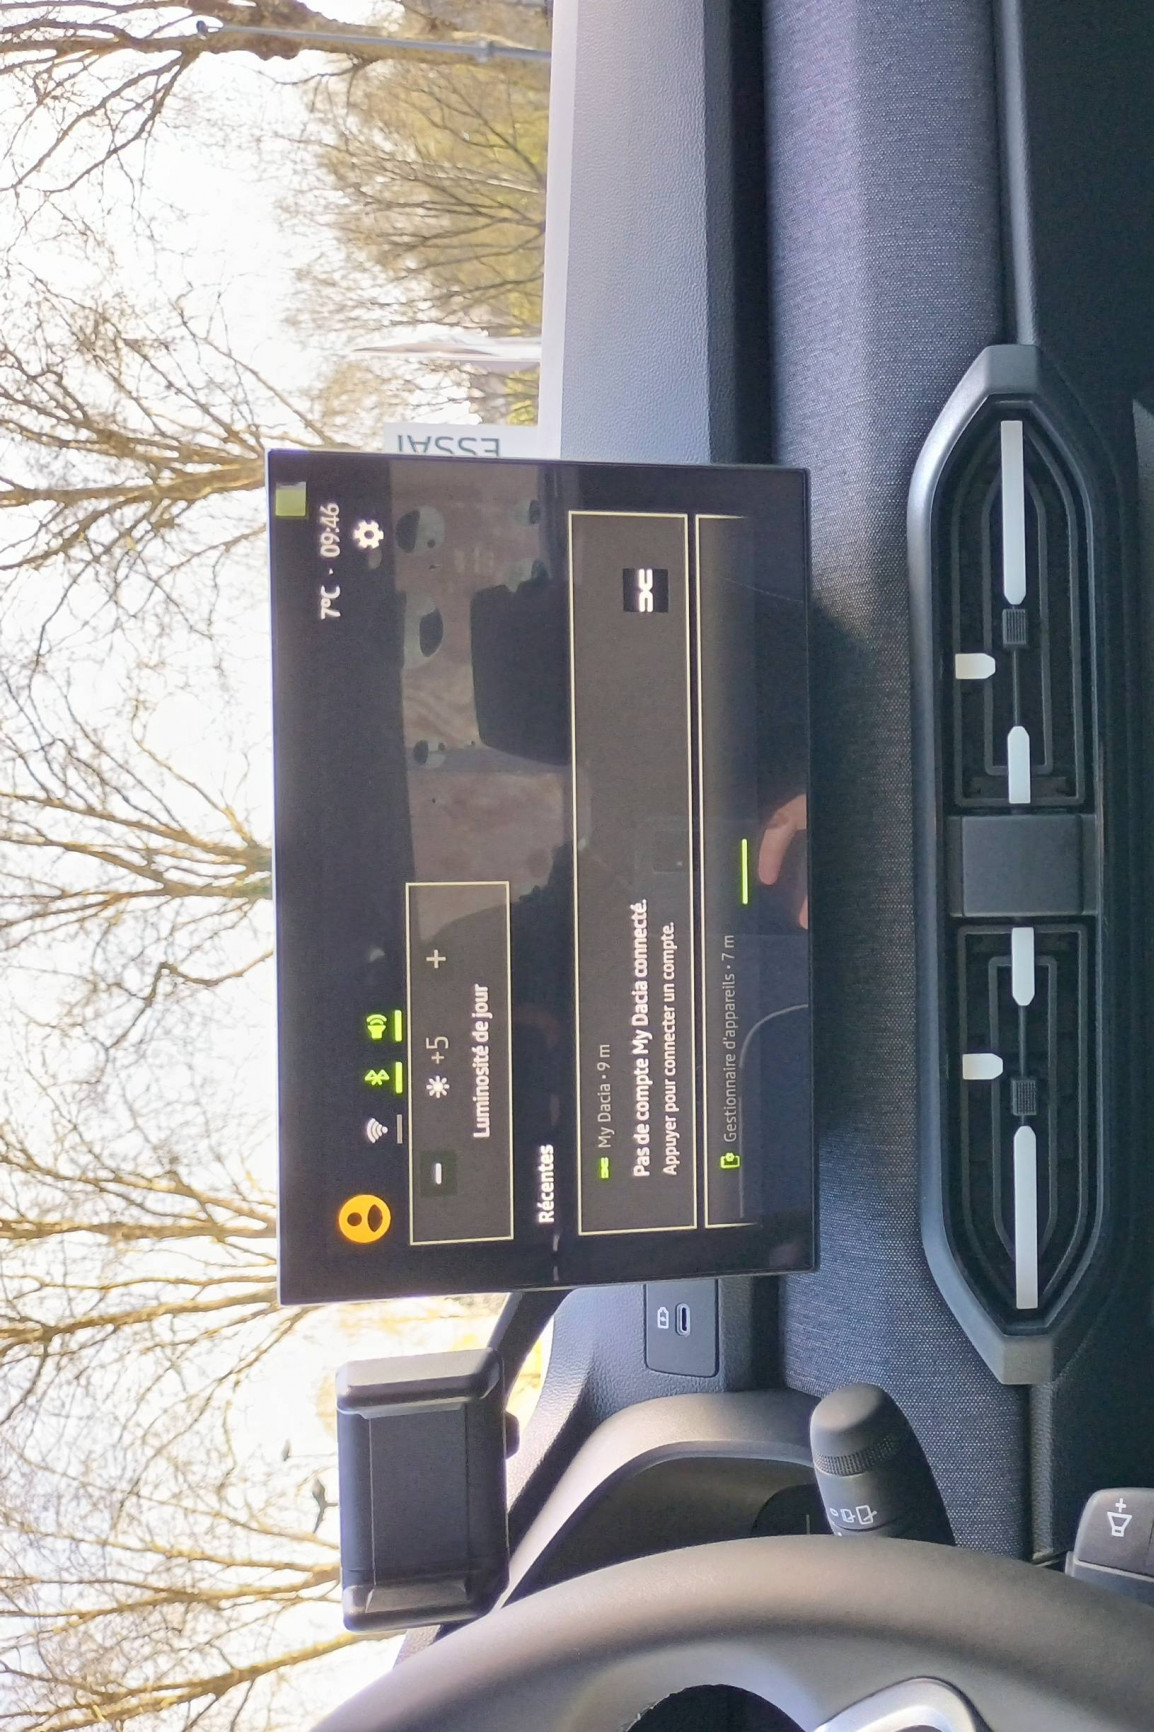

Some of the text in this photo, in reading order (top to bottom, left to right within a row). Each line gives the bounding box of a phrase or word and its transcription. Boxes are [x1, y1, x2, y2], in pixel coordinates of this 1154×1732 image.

[397, 434, 500, 456] ESSAI
[319, 503, 341, 558] 09:46
[426, 1036, 448, 1064] +5
[471, 984, 492, 1138] Luminosité de jour
[629, 899, 652, 1177] Pas de compte My Dacia connecté.
[659, 922, 679, 1176] Appuyer pour connecter un compte.
[720, 935, 738, 1142] Gestionnaire d'appareils 7 m
[596, 1044, 614, 1148] My Dacia 9 m
[537, 1145, 556, 1223] Récentes
